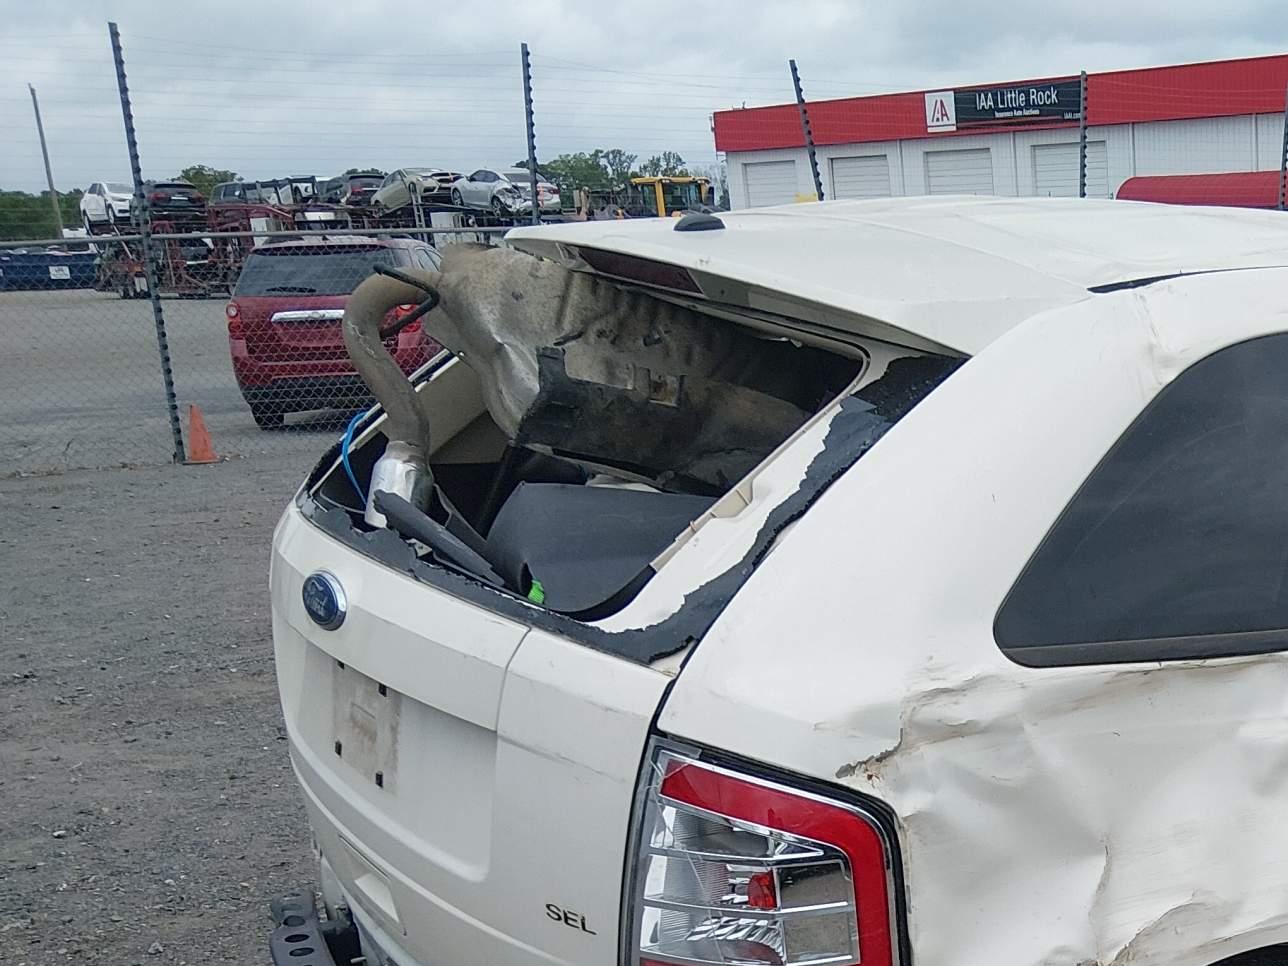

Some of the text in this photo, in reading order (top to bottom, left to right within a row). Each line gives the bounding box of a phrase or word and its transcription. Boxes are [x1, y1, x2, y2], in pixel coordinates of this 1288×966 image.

[976, 86, 1059, 111] IAA Little Rock
[545, 903, 598, 936] SEL
